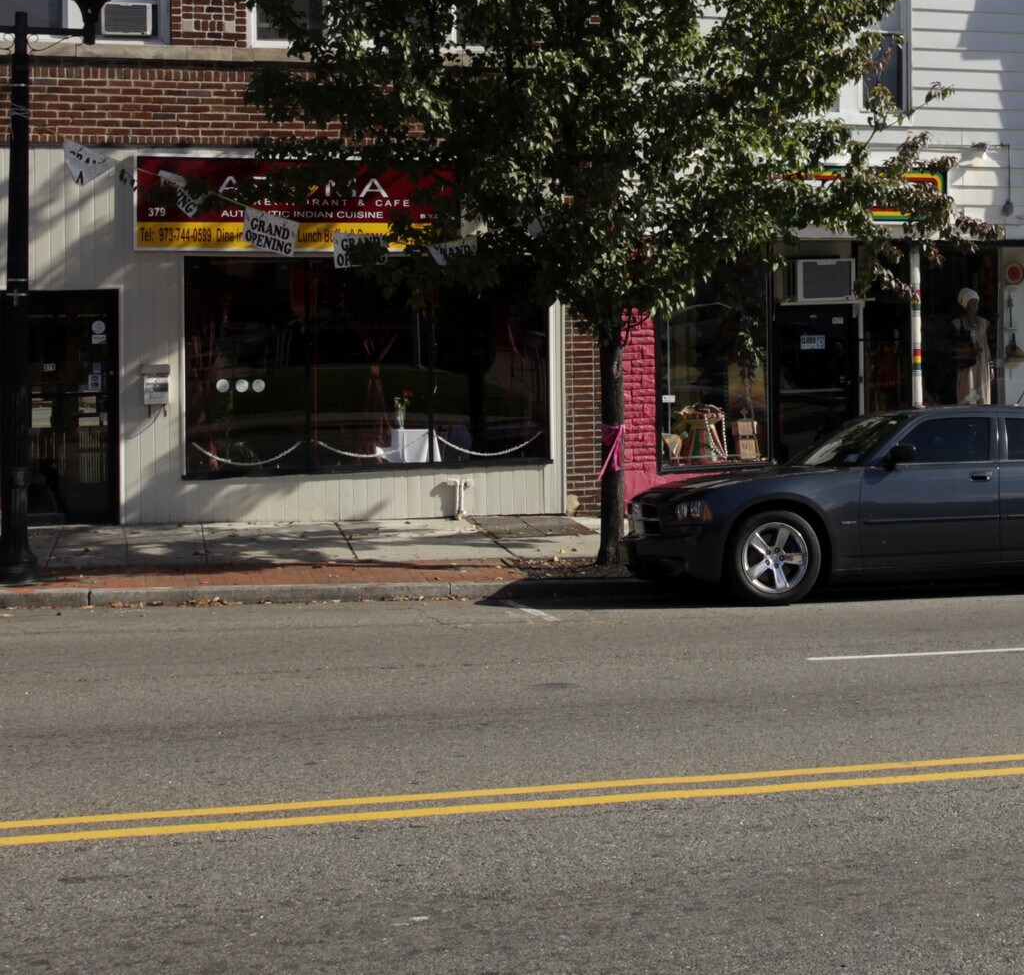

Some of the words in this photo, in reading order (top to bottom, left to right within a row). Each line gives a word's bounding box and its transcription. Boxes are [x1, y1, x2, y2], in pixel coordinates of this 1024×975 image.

[375, 198, 411, 208] CAFE
[148, 206, 167, 217] 379
[293, 210, 334, 219] INDIAN
[336, 210, 384, 219] CUISINE
[140, 227, 155, 242] Tel:
[159, 227, 212, 242] 973-744-0599
[216, 227, 234, 242] Dine
[250, 217, 290, 240] GRAND
[297, 228, 322, 243] Lunch
[245, 230, 292, 255] OPENING
